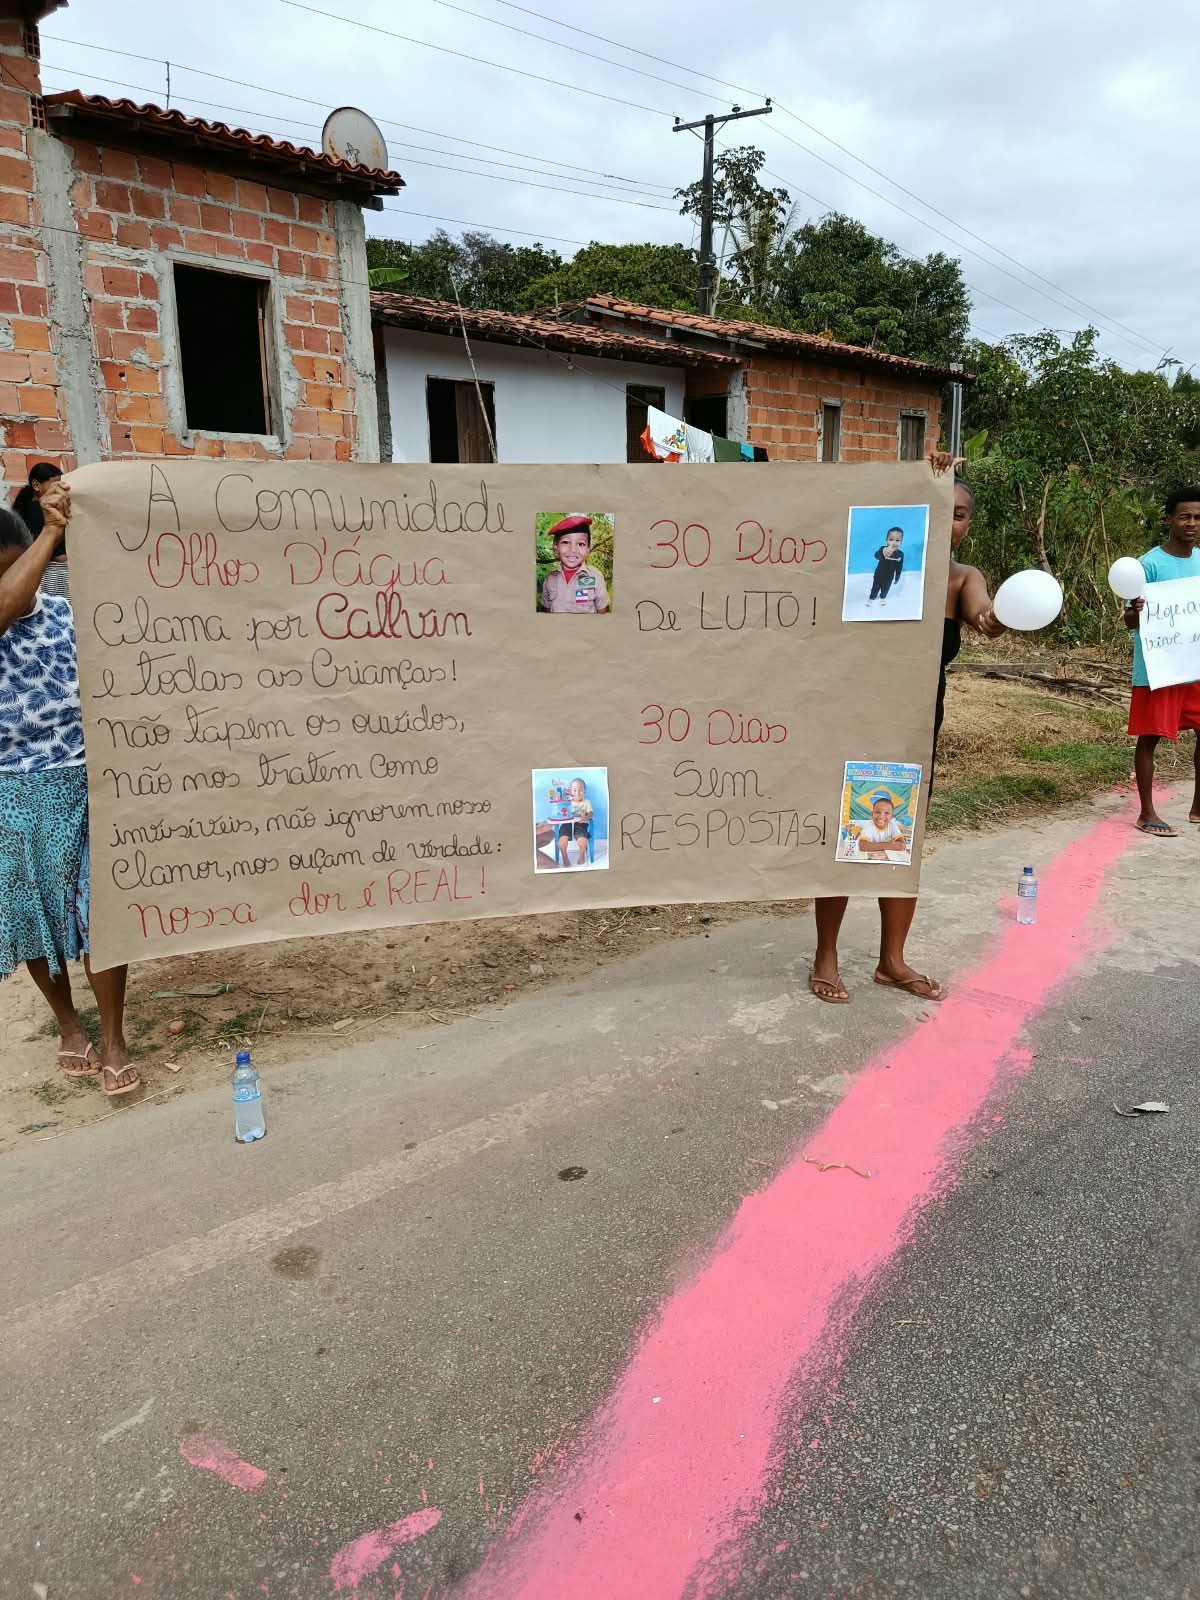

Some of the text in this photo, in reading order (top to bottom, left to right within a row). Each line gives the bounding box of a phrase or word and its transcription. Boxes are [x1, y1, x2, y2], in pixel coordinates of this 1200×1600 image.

[116, 464, 513, 551] A Comunidade
[148, 532, 260, 588] Olhos
[649, 520, 827, 569] 30 Dias
[94, 596, 231, 647] Clama
[246, 615, 309, 650] por
[636, 591, 817, 632] De LUTO!
[92, 668, 122, 698] e
[131, 650, 243, 695] todas
[257, 669, 303, 688] as
[184, 704, 296, 750] tapem
[306, 714, 340, 736] os
[639, 704, 787, 746] 30 Dias
[183, 770, 240, 791] nos
[257, 751, 363, 788] tratem
[266, 806, 316, 832] não
[324, 803, 435, 838] ignorem
[436, 799, 491, 815] nosso
[620, 809, 826, 851] RESPOSTAS!
[289, 848, 365, 874] ouçam
[373, 840, 398, 864] de
[289, 881, 347, 916] dor
